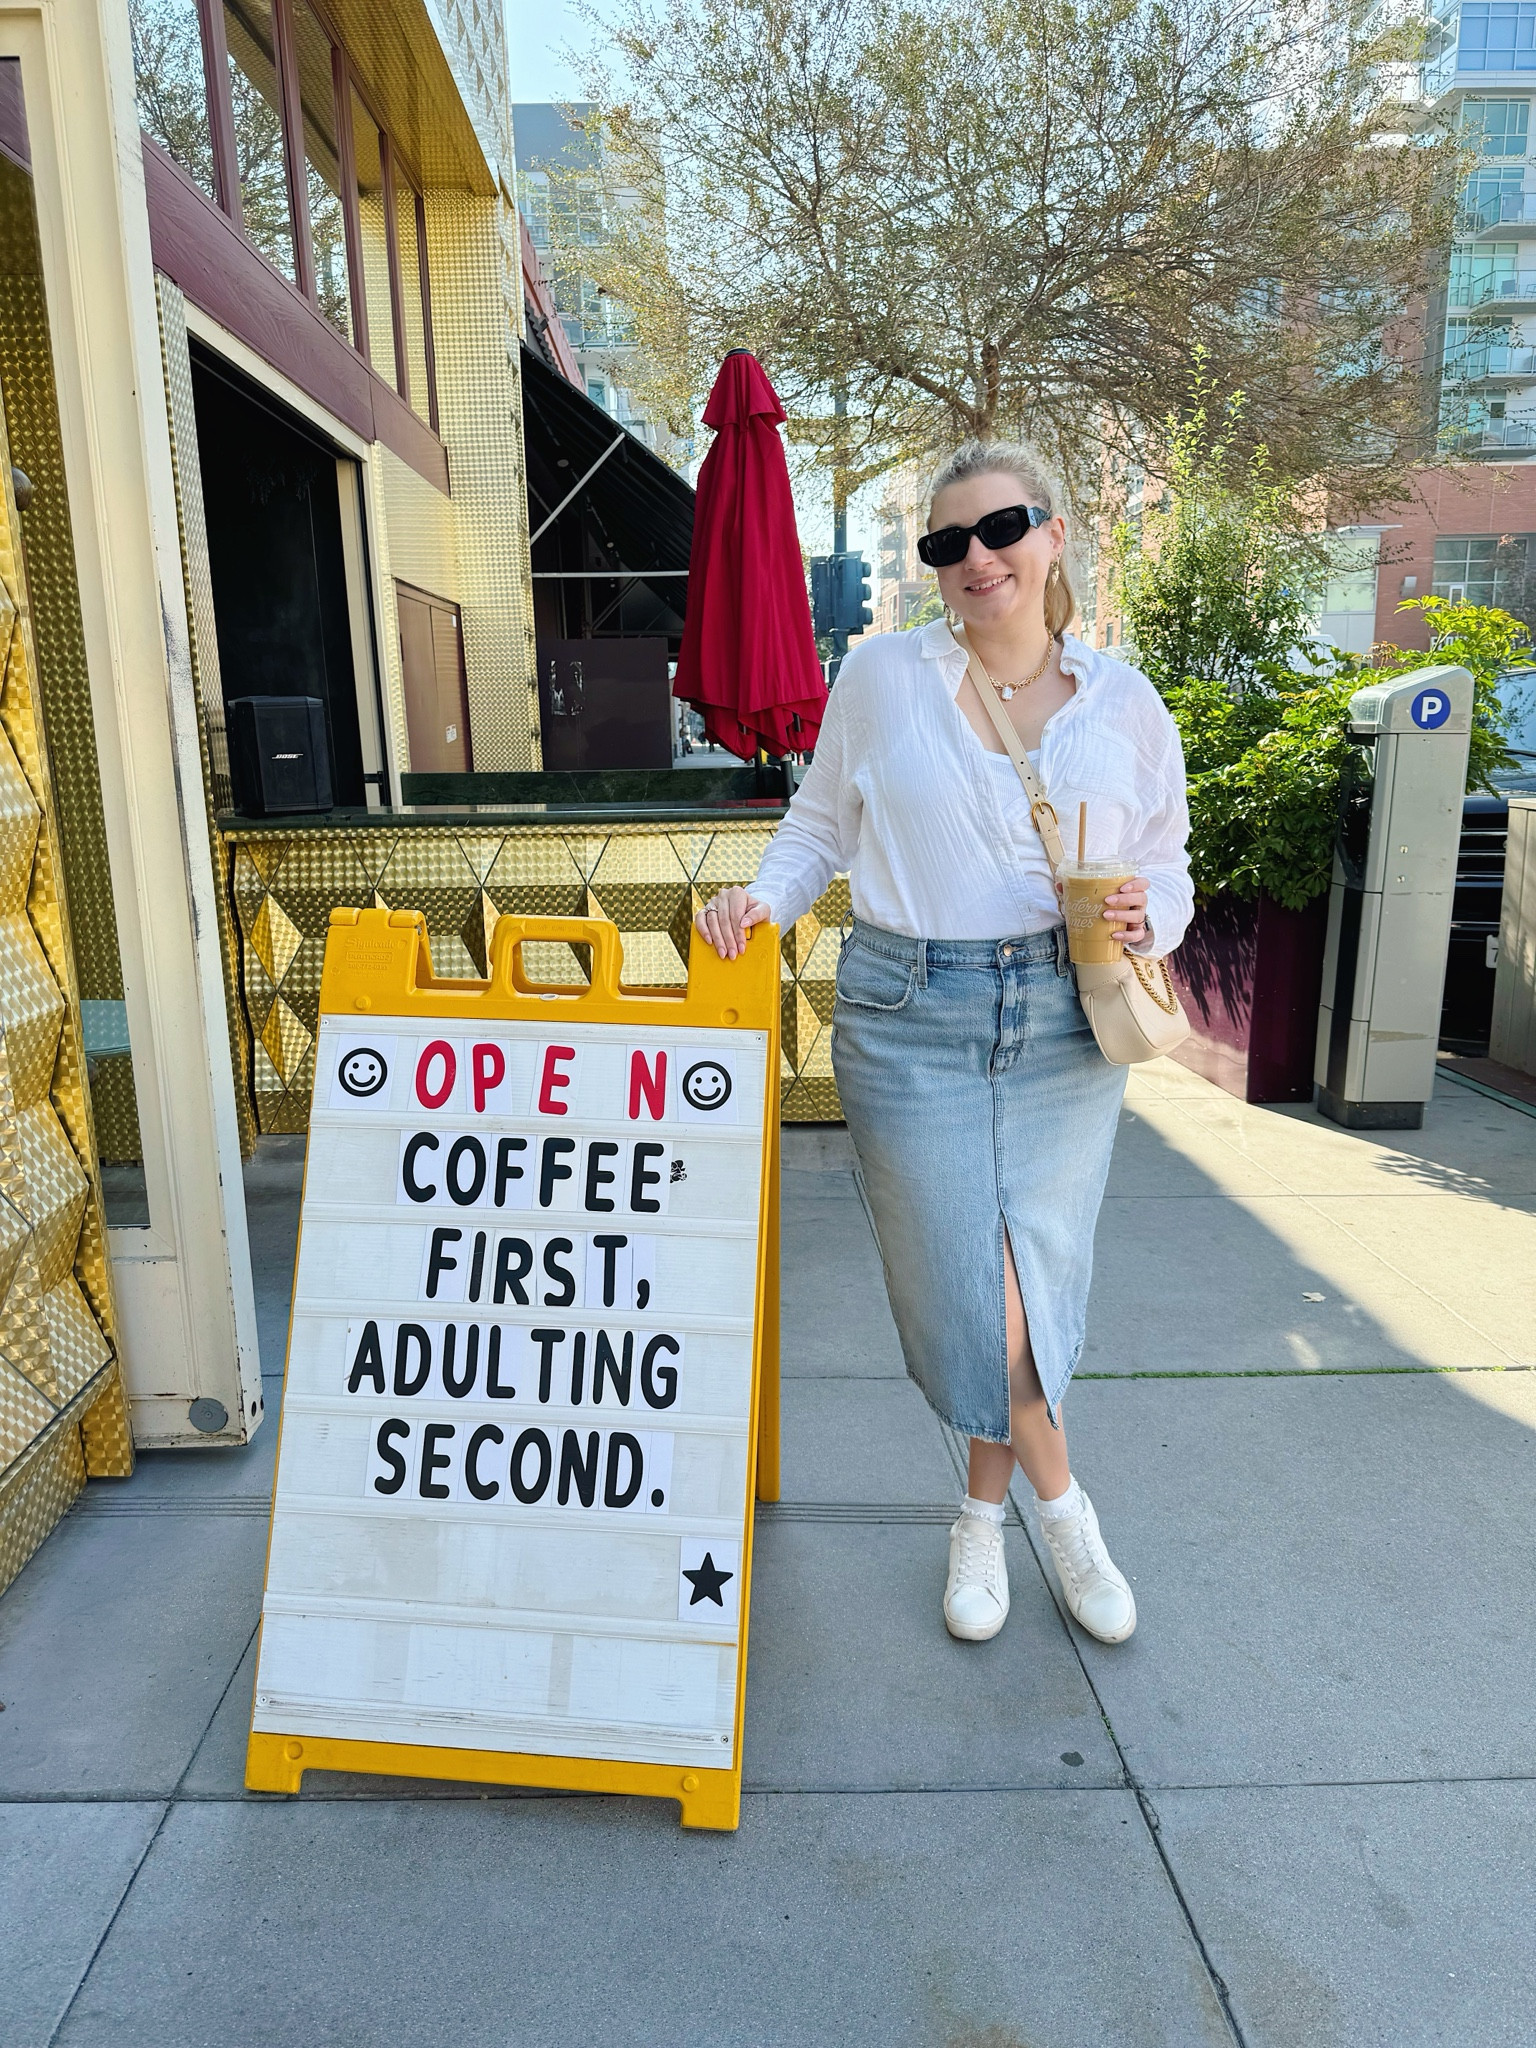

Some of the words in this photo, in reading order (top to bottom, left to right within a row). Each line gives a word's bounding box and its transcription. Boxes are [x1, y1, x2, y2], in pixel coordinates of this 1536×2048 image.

[1420, 696, 1443, 723] P
[1066, 896, 1103, 919] dern
[1067, 915, 1094, 929] mes
[415, 1040, 667, 1121] OPEN
[401, 1131, 666, 1214] COFFEE
[425, 1227, 652, 1310] FIRST,
[346, 1320, 681, 1411] ADULTING
[373, 1418, 666, 1509] SECOND.
